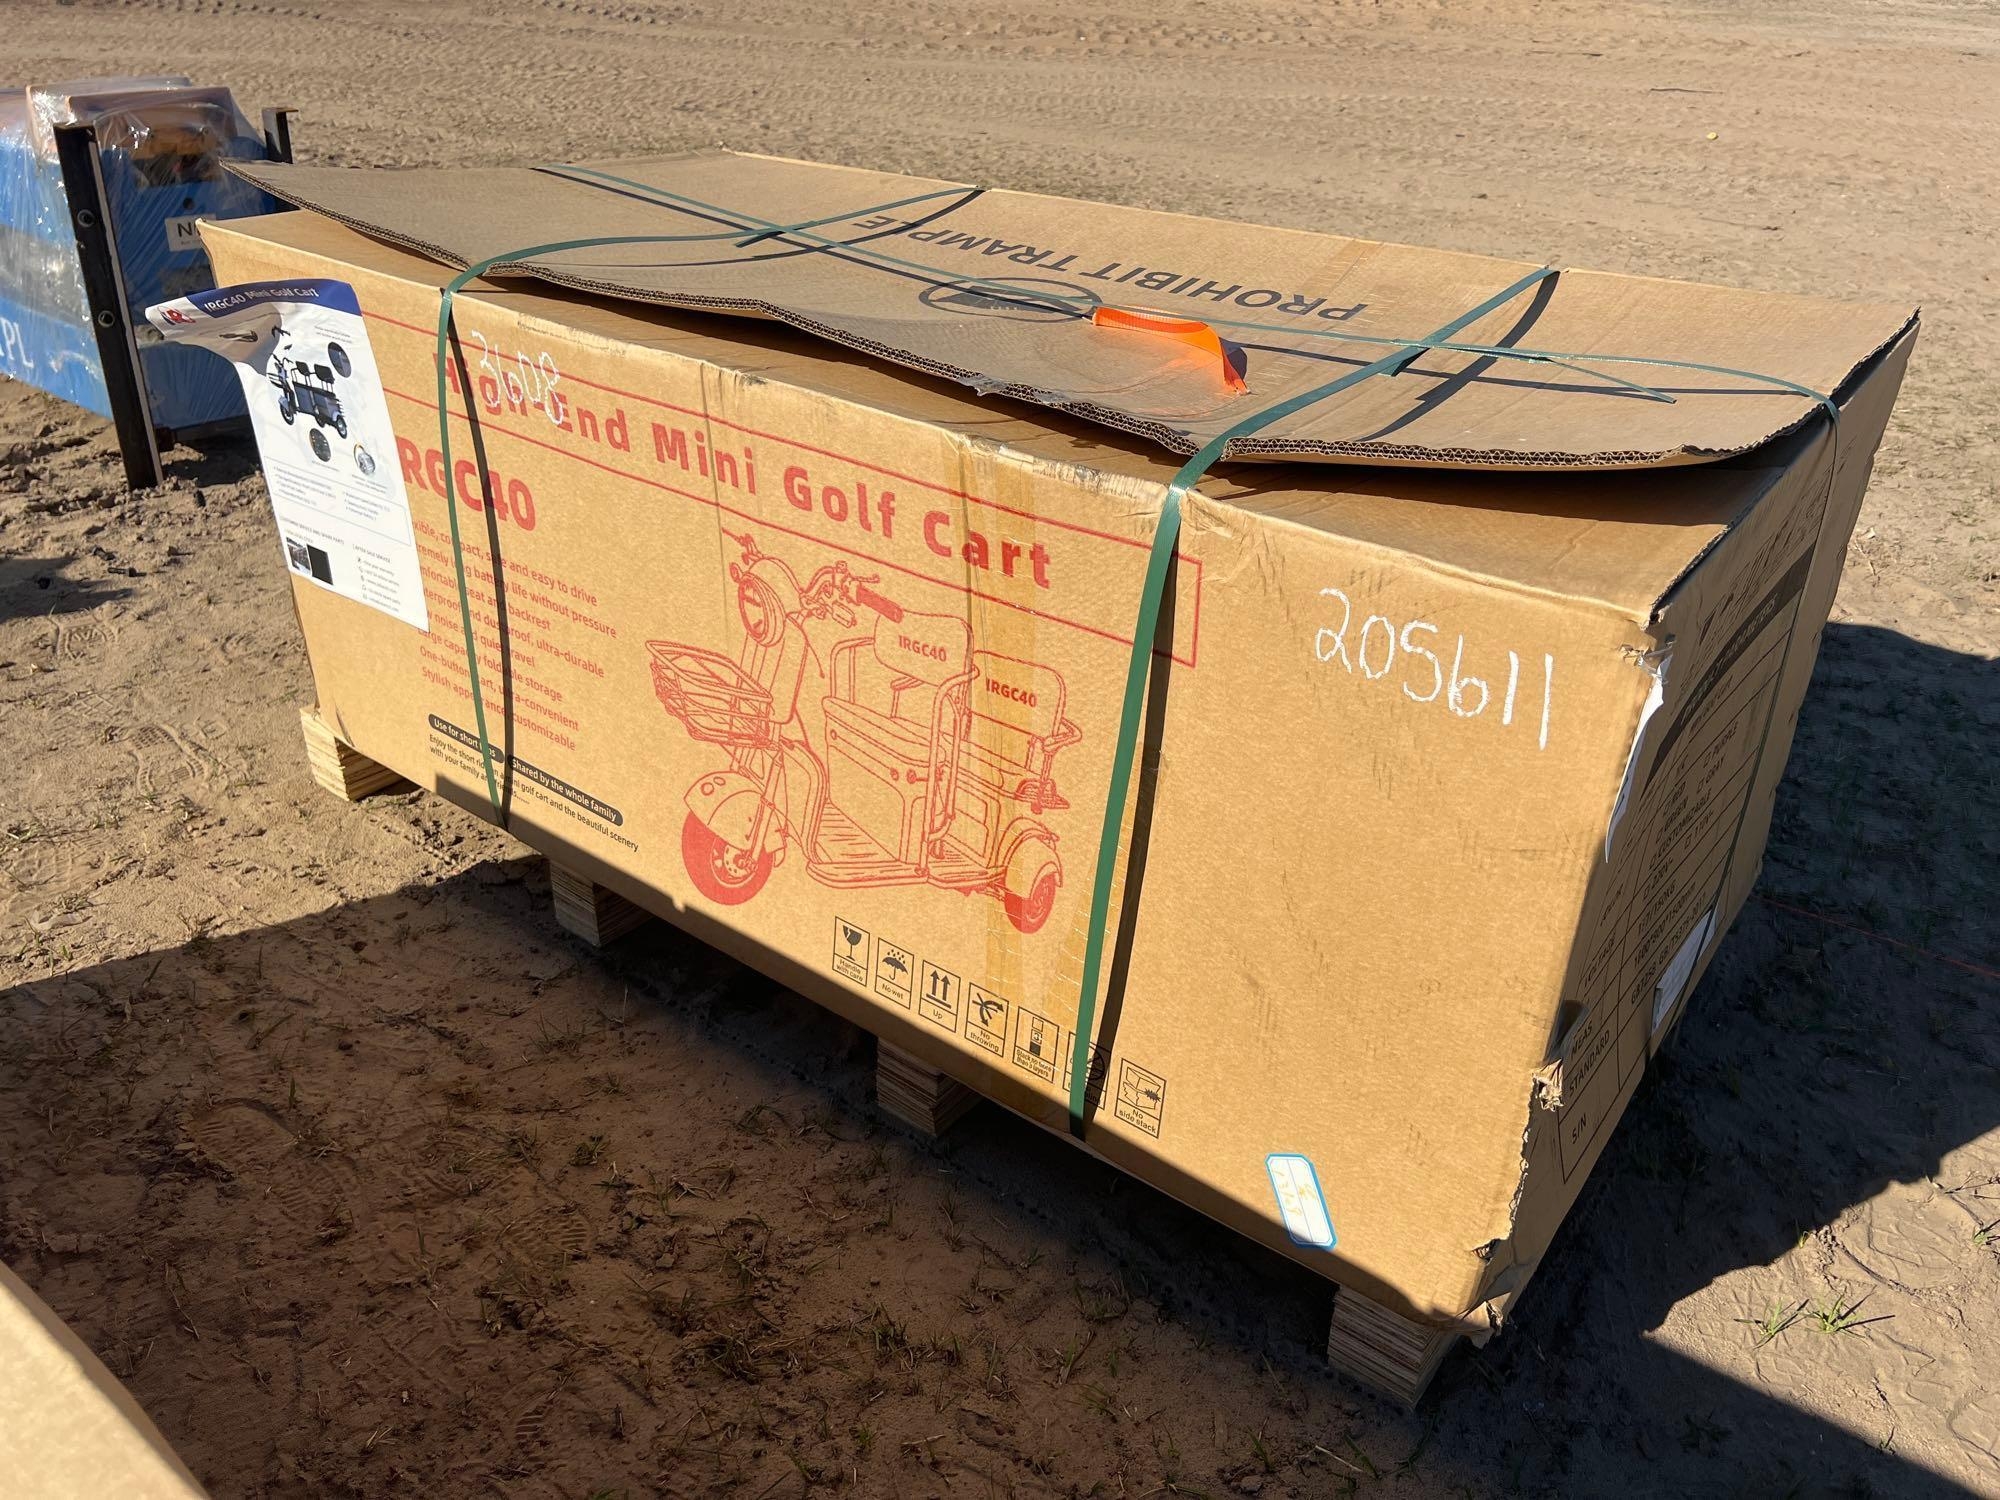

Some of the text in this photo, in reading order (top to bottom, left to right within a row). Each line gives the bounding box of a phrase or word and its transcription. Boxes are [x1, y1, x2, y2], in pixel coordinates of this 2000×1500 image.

[851, 214, 1369, 322] PROHIBIT TRAMPLE
[204, 287, 320, 312] IRGC40 Mini Golf Cart
[395, 435, 536, 531] RGC40
[651, 422, 757, 495] Mini
[783, 465, 896, 539] Golf
[923, 510, 1052, 590] Cart
[413, 520, 438, 541] xible,
[440, 534, 483, 559] copact,
[510, 560, 530, 577] and
[531, 571, 555, 590] easy
[558, 580, 568, 593] to
[570, 586, 597, 606] drive
[416, 544, 449, 566] remely
[511, 582, 528, 599] life
[530, 591, 570, 617] without
[571, 610, 617, 639] pressure
[435, 613, 459, 632] noise
[460, 625, 478, 641] ad
[507, 602, 551, 631] backrest
[420, 646, 470, 677] One-button
[537, 640, 605, 678] ultra-durable
[898, 634, 947, 663] IRGC40
[1315, 587, 1554, 751] 205611
[526, 677, 563, 702] storage
[985, 677, 1038, 708] IRGC40
[422, 667, 451, 688] Stylish
[511, 713, 577, 751] customizable
[434, 718, 478, 748] Use for short
[430, 746, 444, 758] with
[445, 754, 459, 766] your
[459, 761, 480, 779] family
[429, 734, 446, 750] Enjoy
[447, 743, 459, 755] the
[459, 749, 475, 764] short
[521, 783, 534, 795] golf
[535, 790, 549, 804] cart
[550, 799, 563, 811] and
[564, 805, 576, 819] the
[577, 812, 609, 836] beautiful
[610, 831, 639, 853] scenery
[540, 772, 550, 787] by
[551, 779, 564, 793] the
[565, 788, 590, 808] whole
[590, 800, 617, 822] family
[836, 964, 863, 982] with care
[840, 959, 861, 975] Handle
[882, 983, 904, 1000] No wet
[932, 1008, 943, 1019] Up
[970, 1032, 1000, 1053] throwing
[980, 1029, 991, 1040] No
[1569, 1029, 1611, 1098] STANDARD
[1119, 1110, 1156, 1134] side stack
[1133, 1109, 1144, 1119] No
[1571, 1112, 1587, 1145] S/N
